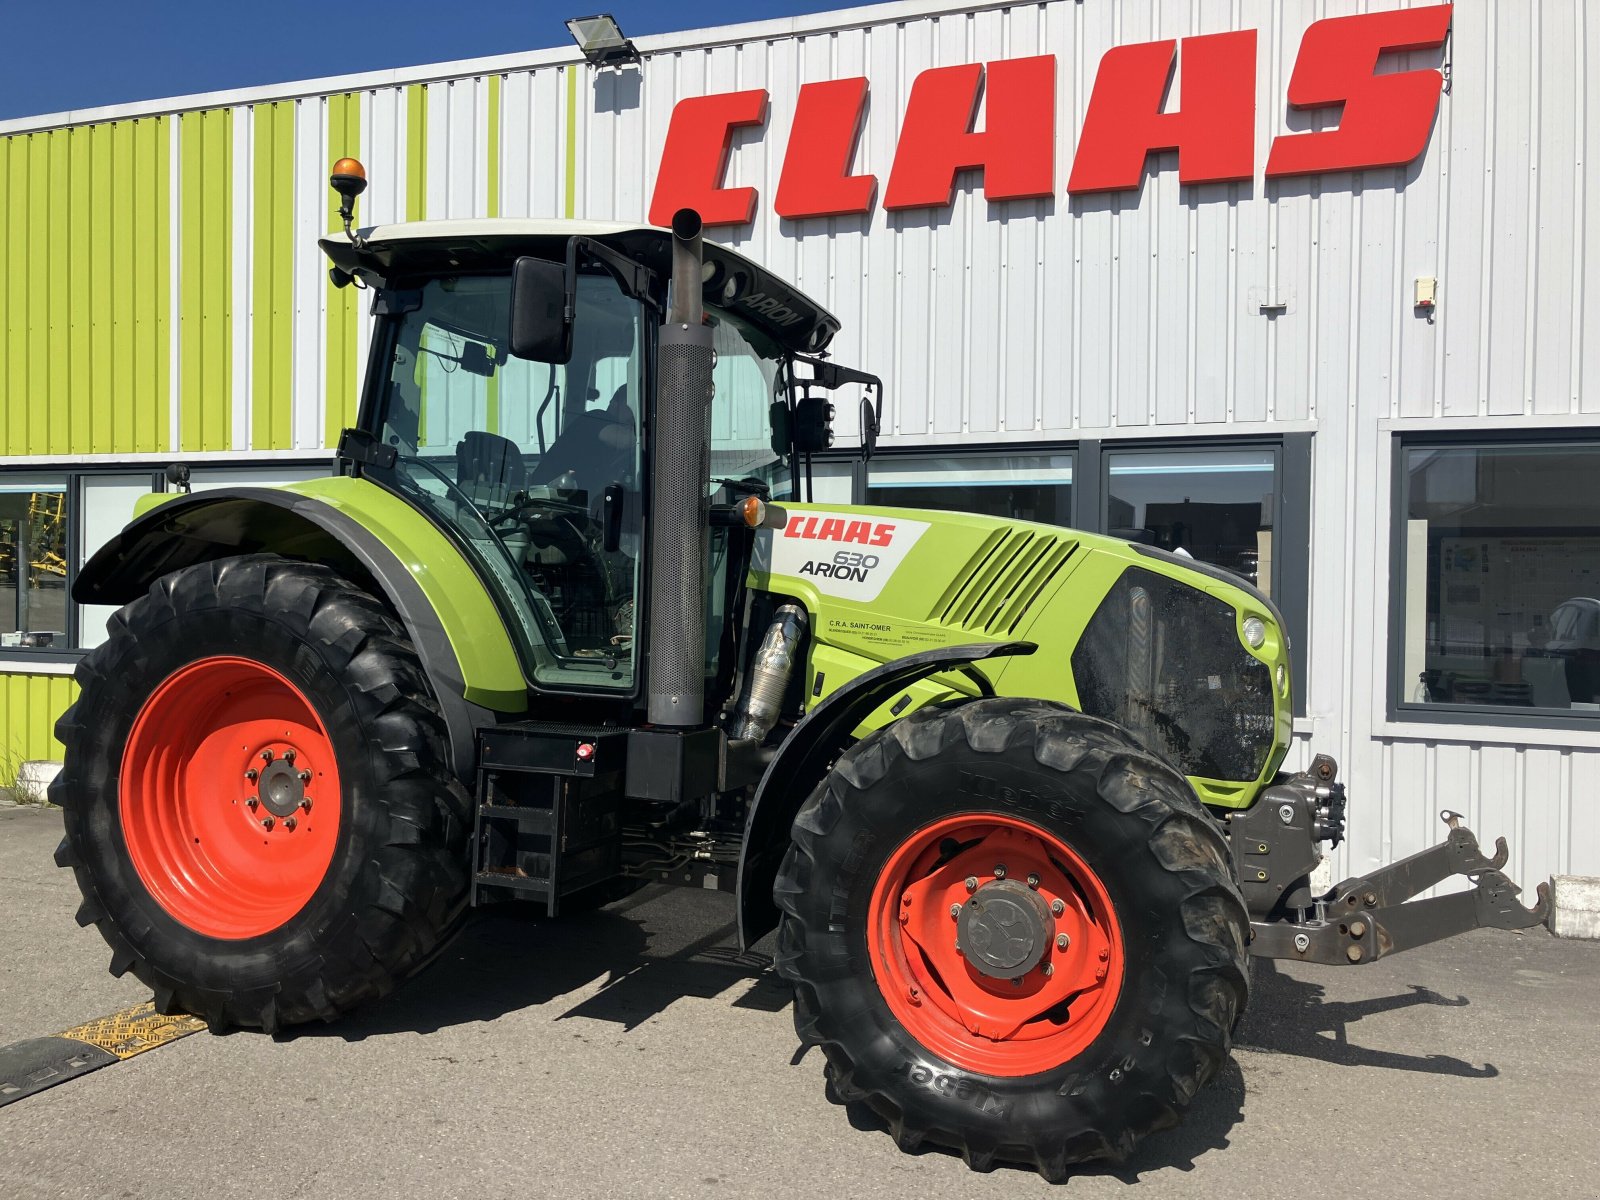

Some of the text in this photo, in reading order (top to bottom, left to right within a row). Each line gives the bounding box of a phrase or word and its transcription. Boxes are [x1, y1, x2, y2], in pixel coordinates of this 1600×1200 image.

[649, 4, 1453, 226] CLAAS
[740, 291, 803, 326] ARION
[784, 516, 896, 547] CLAAS
[799, 560, 868, 582] ARION
[833, 550, 880, 569] 630
[829, 620, 848, 629] C.R.A.
[849, 622, 891, 632] SAINT-OMER
